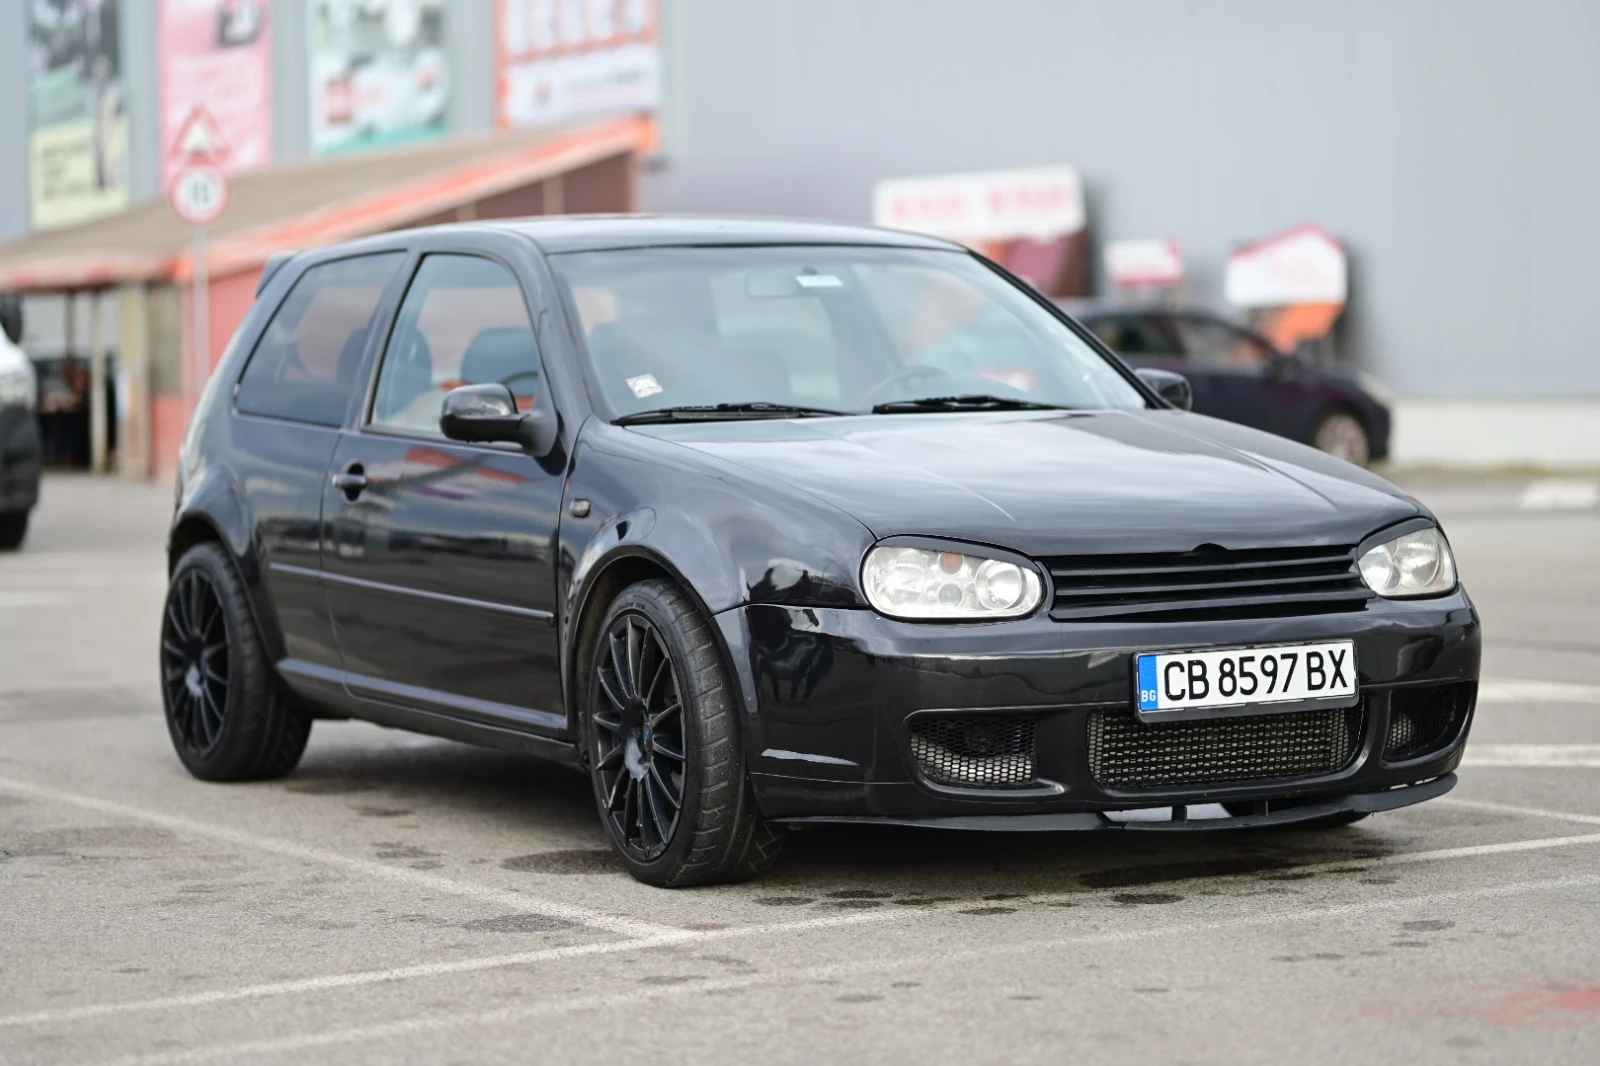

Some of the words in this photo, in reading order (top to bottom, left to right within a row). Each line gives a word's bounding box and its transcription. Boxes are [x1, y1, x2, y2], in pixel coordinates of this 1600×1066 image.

[1164, 660, 1209, 701] CB
[1218, 653, 1298, 697] 8597
[1306, 649, 1348, 691] BX
[1141, 690, 1156, 703] BG
